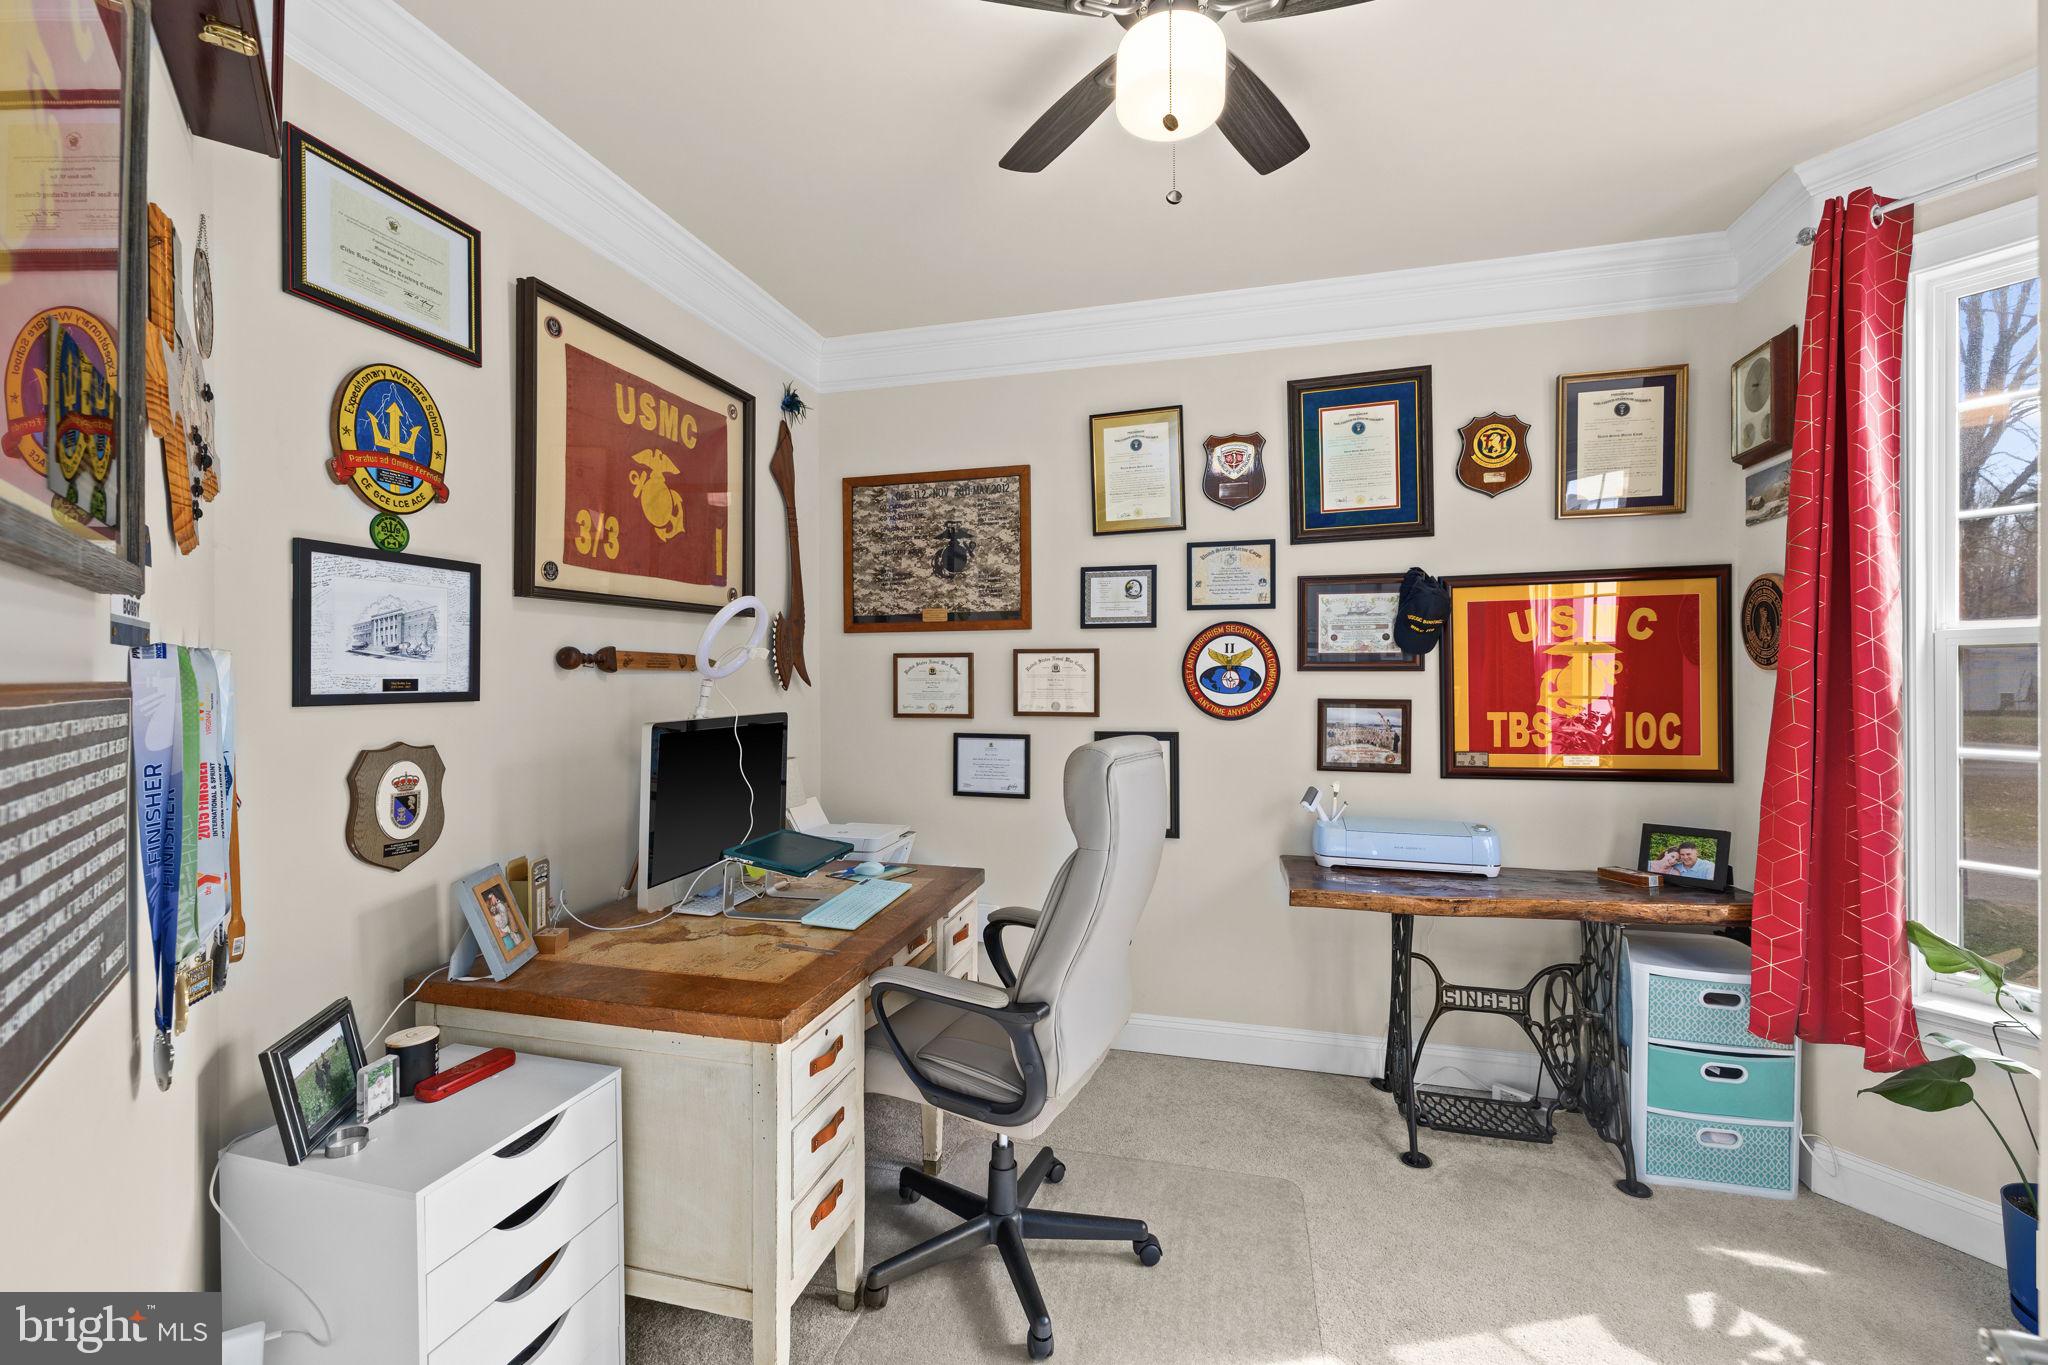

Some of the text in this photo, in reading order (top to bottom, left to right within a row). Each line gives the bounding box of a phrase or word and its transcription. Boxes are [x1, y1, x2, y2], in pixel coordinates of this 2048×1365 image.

[344, 369, 441, 437] Expeditionary Warfare School
[615, 382, 698, 450] USMC
[379, 456, 389, 464] ad
[361, 477, 373, 490] CE
[373, 490, 391, 505] GCE
[393, 500, 410, 508] LCE
[412, 492, 426, 506] ACE
[574, 508, 620, 560] 3/3
[1225, 624, 1261, 641] SECURITY
[1508, 605, 1658, 643] USC
[1259, 639, 1274, 657] TEAM
[1265, 658, 1278, 692] COMPANY
[1197, 696, 1264, 716] ANYTIME ANYPLACE
[1487, 711, 1682, 750] TBS IOC
[144, 763, 163, 866] FINISHER
[210, 791, 219, 837] INTERNATIONAL
[1442, 989, 1525, 1011] SINGER
